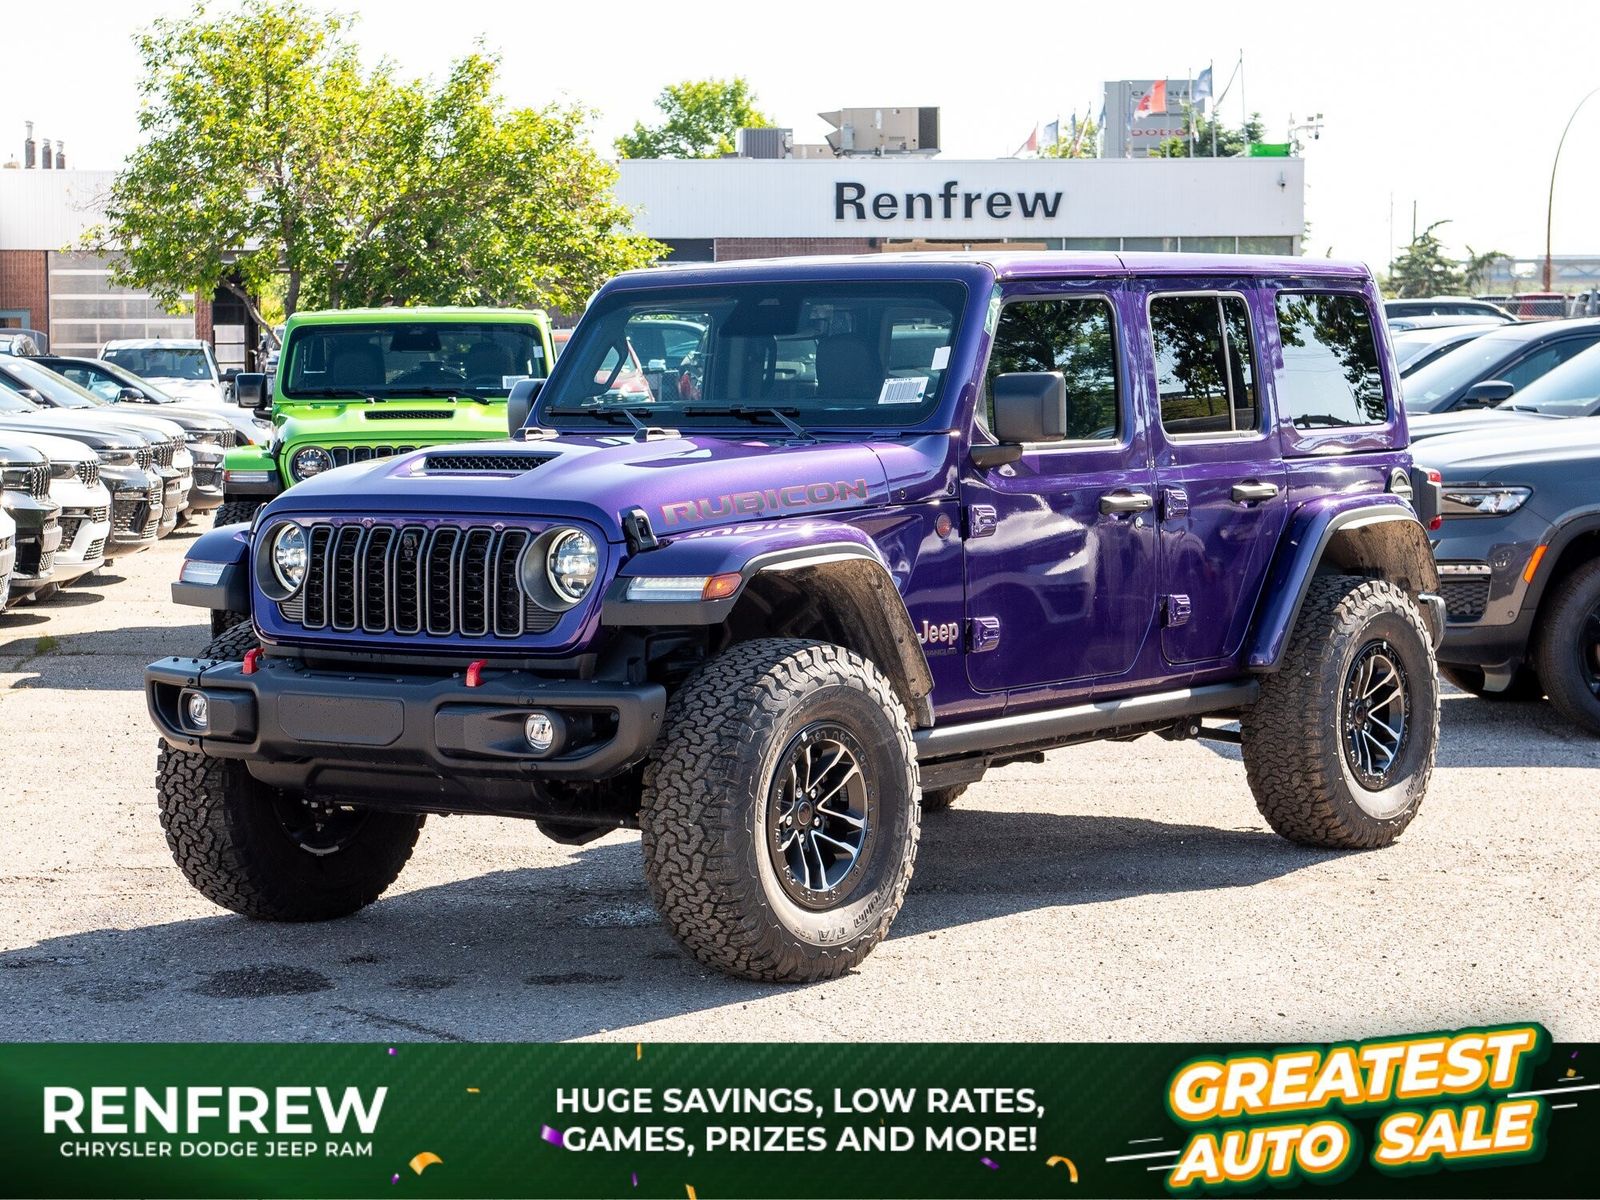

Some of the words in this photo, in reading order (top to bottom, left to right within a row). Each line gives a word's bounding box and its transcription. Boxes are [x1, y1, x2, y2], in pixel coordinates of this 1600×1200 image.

[835, 181, 1062, 221] Renfrew
[661, 479, 869, 526] RUBICON
[917, 620, 959, 646] Jeep
